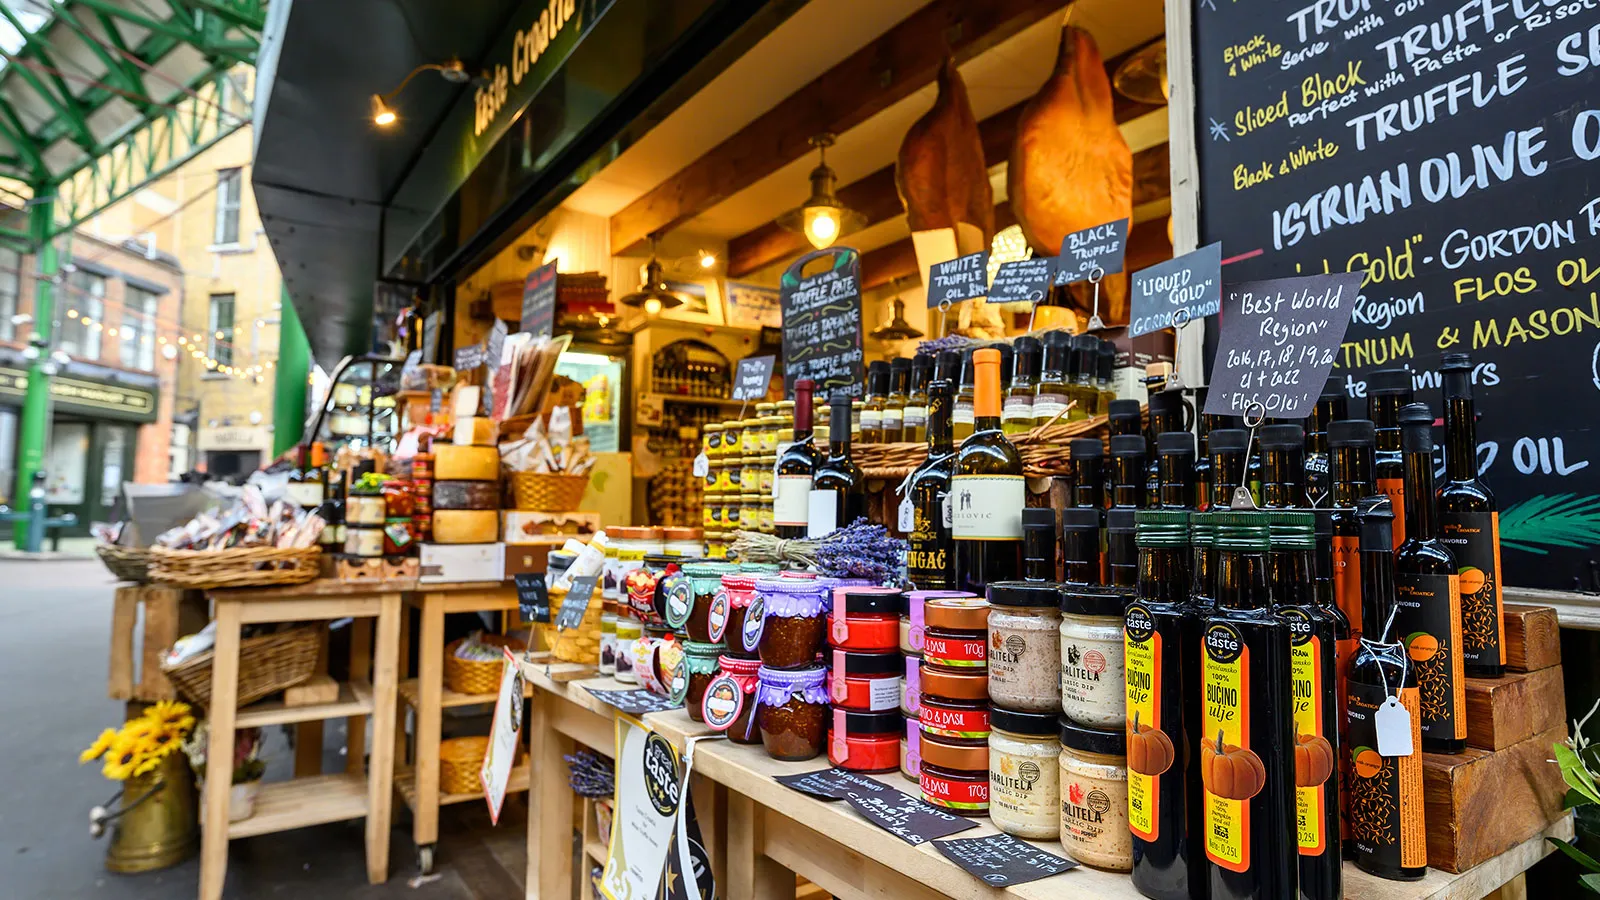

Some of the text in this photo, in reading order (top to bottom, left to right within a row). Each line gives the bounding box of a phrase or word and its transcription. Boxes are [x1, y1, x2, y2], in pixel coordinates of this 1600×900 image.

[1286, 0, 1371, 43] TRU
[1223, 34, 1266, 63] Black
[1280, 42, 1330, 70] Serve
[1344, 14, 1384, 40] with
[1241, 42, 1282, 71] White
[1288, 90, 1357, 128] Perfect
[1364, 71, 1405, 99] with
[1412, 41, 1481, 76] Pasta
[1494, 25, 1519, 43] or
[1234, 90, 1289, 137] Sliced
[1301, 61, 1366, 108] Black
[1233, 165, 1274, 190] Black
[1289, 138, 1339, 169] White
[1346, 54, 1528, 151] TRUFFLE
[1272, 162, 1412, 251] ISTRIAN
[1420, 127, 1548, 203] OLIVE
[1068, 225, 1117, 250] BLACK
[1440, 219, 1576, 269] GORDON
[1072, 241, 1119, 260] TRUFFLE
[940, 254, 981, 274] WHITE
[1079, 260, 1099, 272] OIL
[790, 284, 828, 306] TRUFFLE
[830, 276, 855, 297] PATE
[935, 270, 982, 287] TRUFFLE
[946, 287, 964, 299] OIL
[1291, 285, 1342, 310] World
[1352, 292, 1425, 330] Region
[1455, 267, 1537, 304] FLOS
[1333, 333, 1414, 368] TNUM
[1437, 326, 1460, 350] &
[1512, 437, 1590, 476] OIL
[1127, 617, 1151, 630] taste
[1212, 631, 1230, 639] great
[1290, 622, 1311, 632] ste
[963, 643, 984, 658] 170g
[1206, 636, 1238, 651] taste
[1127, 667, 1150, 690] BUČINO
[1212, 673, 1230, 682] 100%
[1129, 688, 1149, 704] ulje
[1206, 682, 1237, 707] BUČINO
[934, 710, 941, 723] &
[1208, 705, 1235, 723] ulje
[655, 744, 674, 774] great
[646, 747, 679, 805] taste
[967, 785, 988, 799] 170g
[1015, 792, 1028, 800] DIP
[847, 791, 906, 829] CHUTNEY
[867, 797, 909, 822] BASIL
[899, 793, 956, 822] TOMATO
[1087, 824, 1104, 834] DIP
[999, 833, 1015, 845] Try
[1036, 853, 1066, 866] new
[1221, 844, 1238, 858] 0,25L
